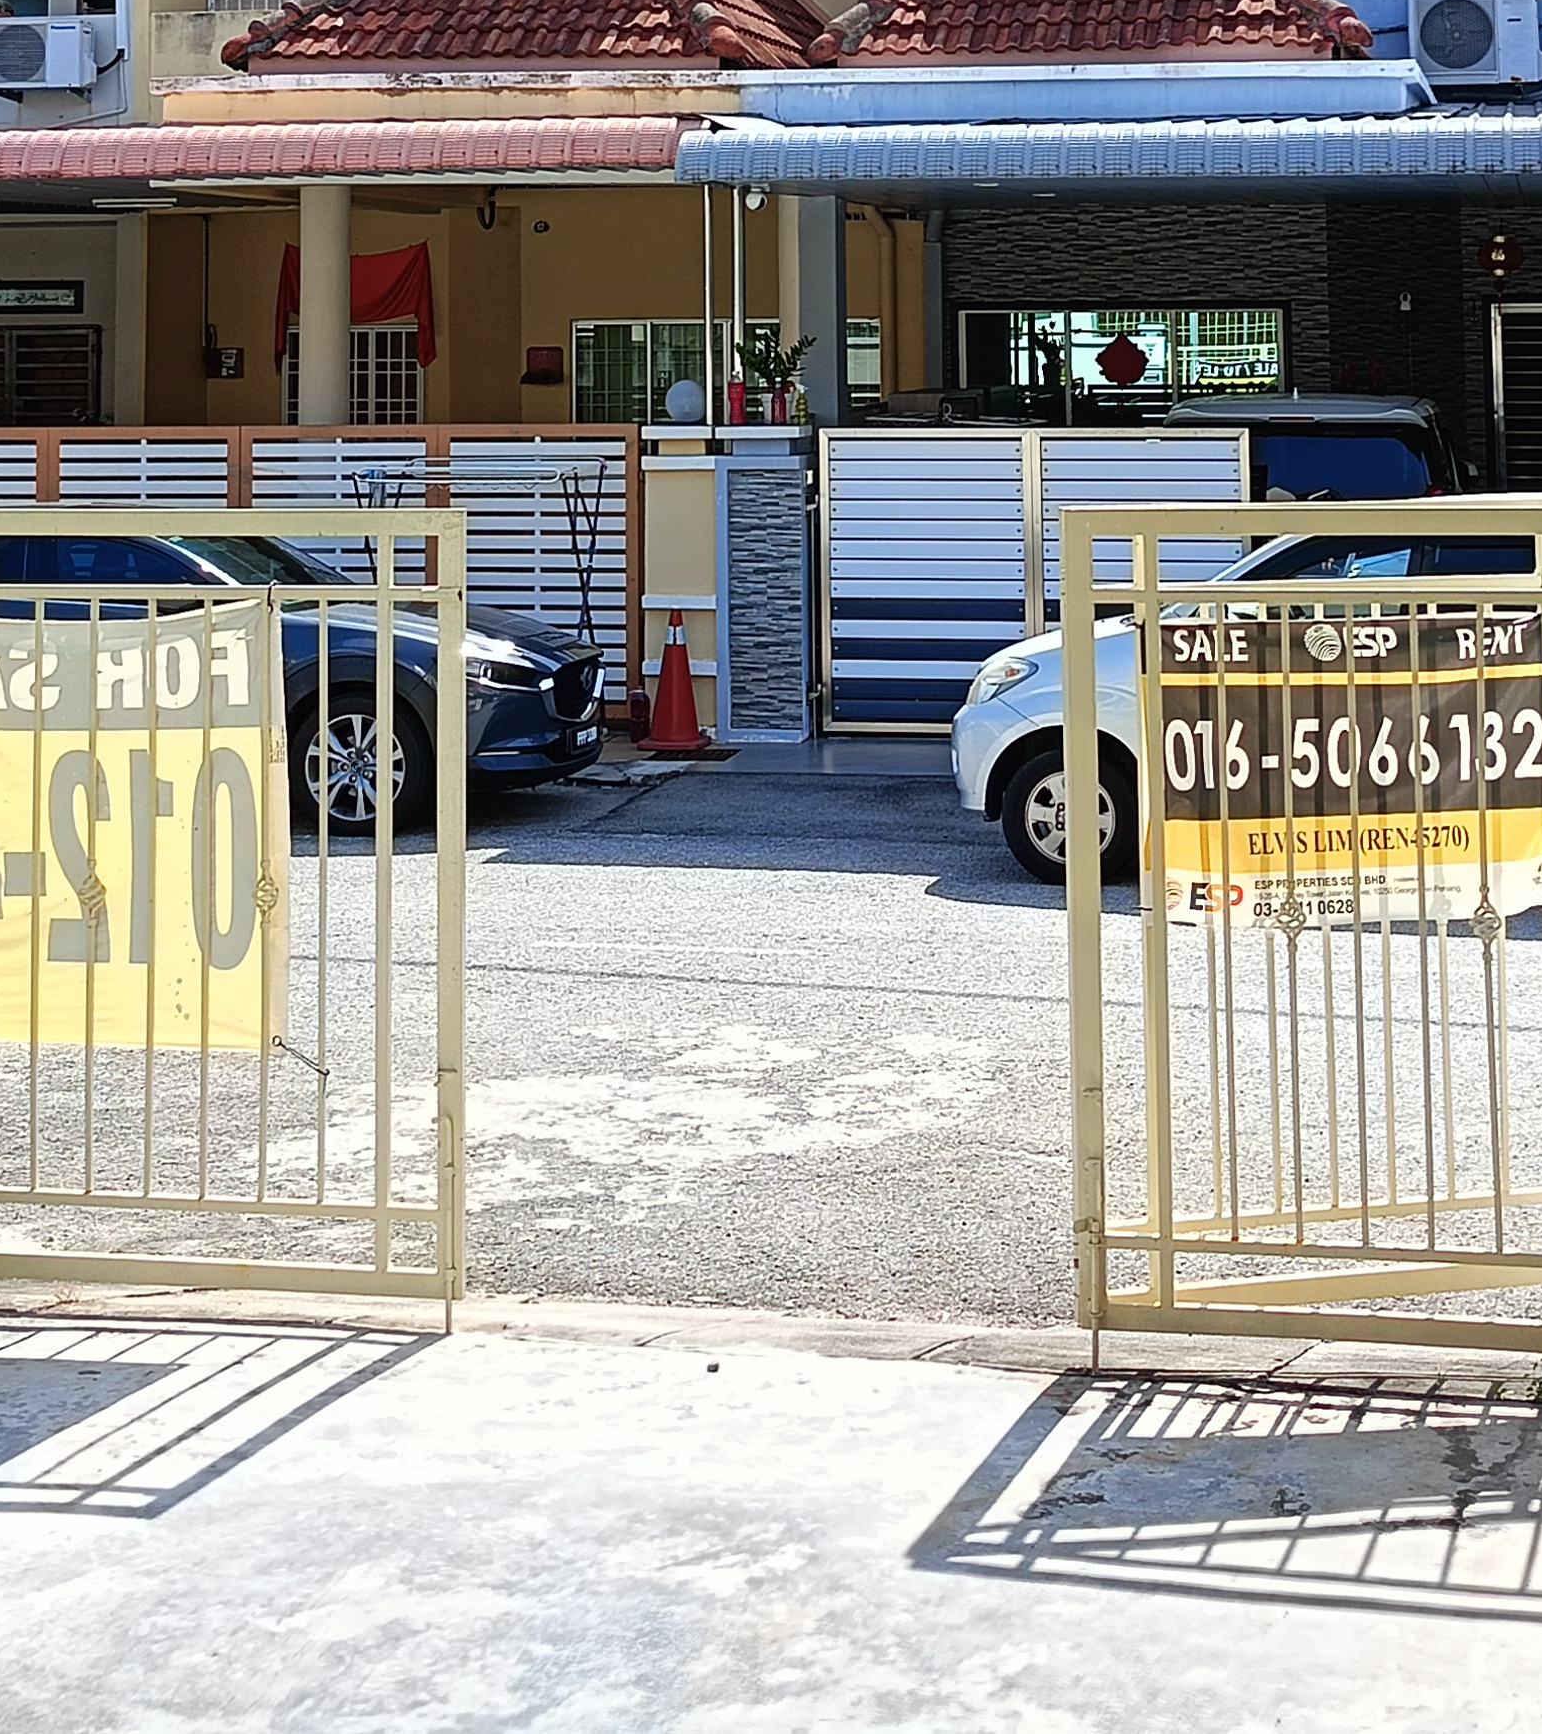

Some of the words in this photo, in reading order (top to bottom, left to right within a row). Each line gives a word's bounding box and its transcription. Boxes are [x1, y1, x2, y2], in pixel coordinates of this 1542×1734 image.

[1173, 628, 1249, 663] SALE
[1343, 625, 1398, 659] ESP
[1455, 622, 1529, 661] RENT
[1313, 829, 1354, 854] LIM
[1189, 881, 1244, 913] ESP
[1254, 879, 1274, 890] ESP
[1275, 876, 1338, 889] PRPERTIES
[1340, 876, 1361, 886] SD
[1364, 875, 1386, 885] BHD
[1317, 898, 1354, 915] 0628
